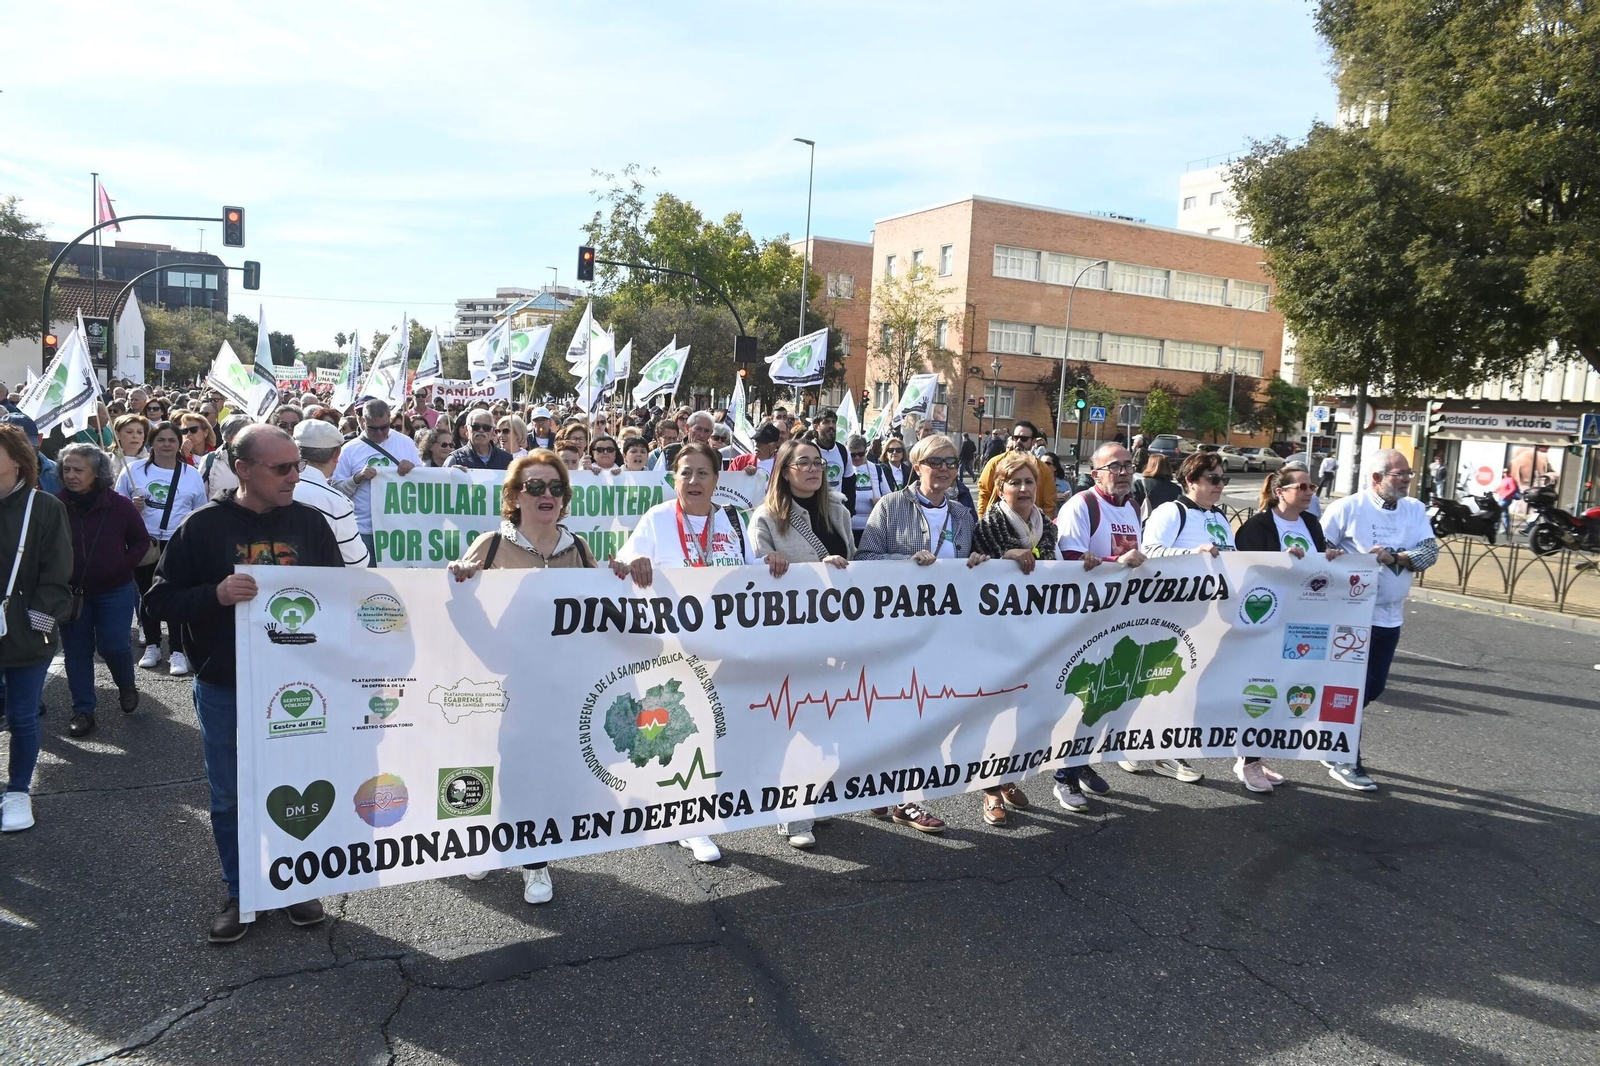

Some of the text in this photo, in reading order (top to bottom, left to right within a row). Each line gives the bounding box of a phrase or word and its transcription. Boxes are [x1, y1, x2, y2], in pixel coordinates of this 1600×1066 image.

[437, 386, 495, 396] SANIDAD
[1444, 416, 1499, 426] veterinario
[1506, 417, 1552, 429] victoria
[384, 482, 486, 516] AGUILAR
[571, 485, 663, 516] RONTERA
[1111, 524, 1136, 533] BAENA
[375, 530, 422, 562] POR
[429, 529, 460, 562] SU
[551, 571, 1230, 636] DINERO PÚBLICO PARA SANIDAD PÚBLICA
[1056, 628, 1109, 690] COORDINADORA
[1110, 618, 1150, 633] ANDALUZA
[1160, 620, 1186, 638] MAREAS
[1182, 634, 1197, 669] BLANCAS
[1146, 667, 1173, 678] CAMB
[579, 652, 727, 792] COORDINADORA EN DEFENSA DE LA SANIDAD PÚBLICA DEL ÁREA SUR DE CÓRDOBA
[463, 770, 483, 778] DEFENSA
[269, 723, 1350, 891] COORDINADORA EN DEFENSA DE LA SANIDAD PÚBLICA DEL ÁREA SUR DE CORDOBA
